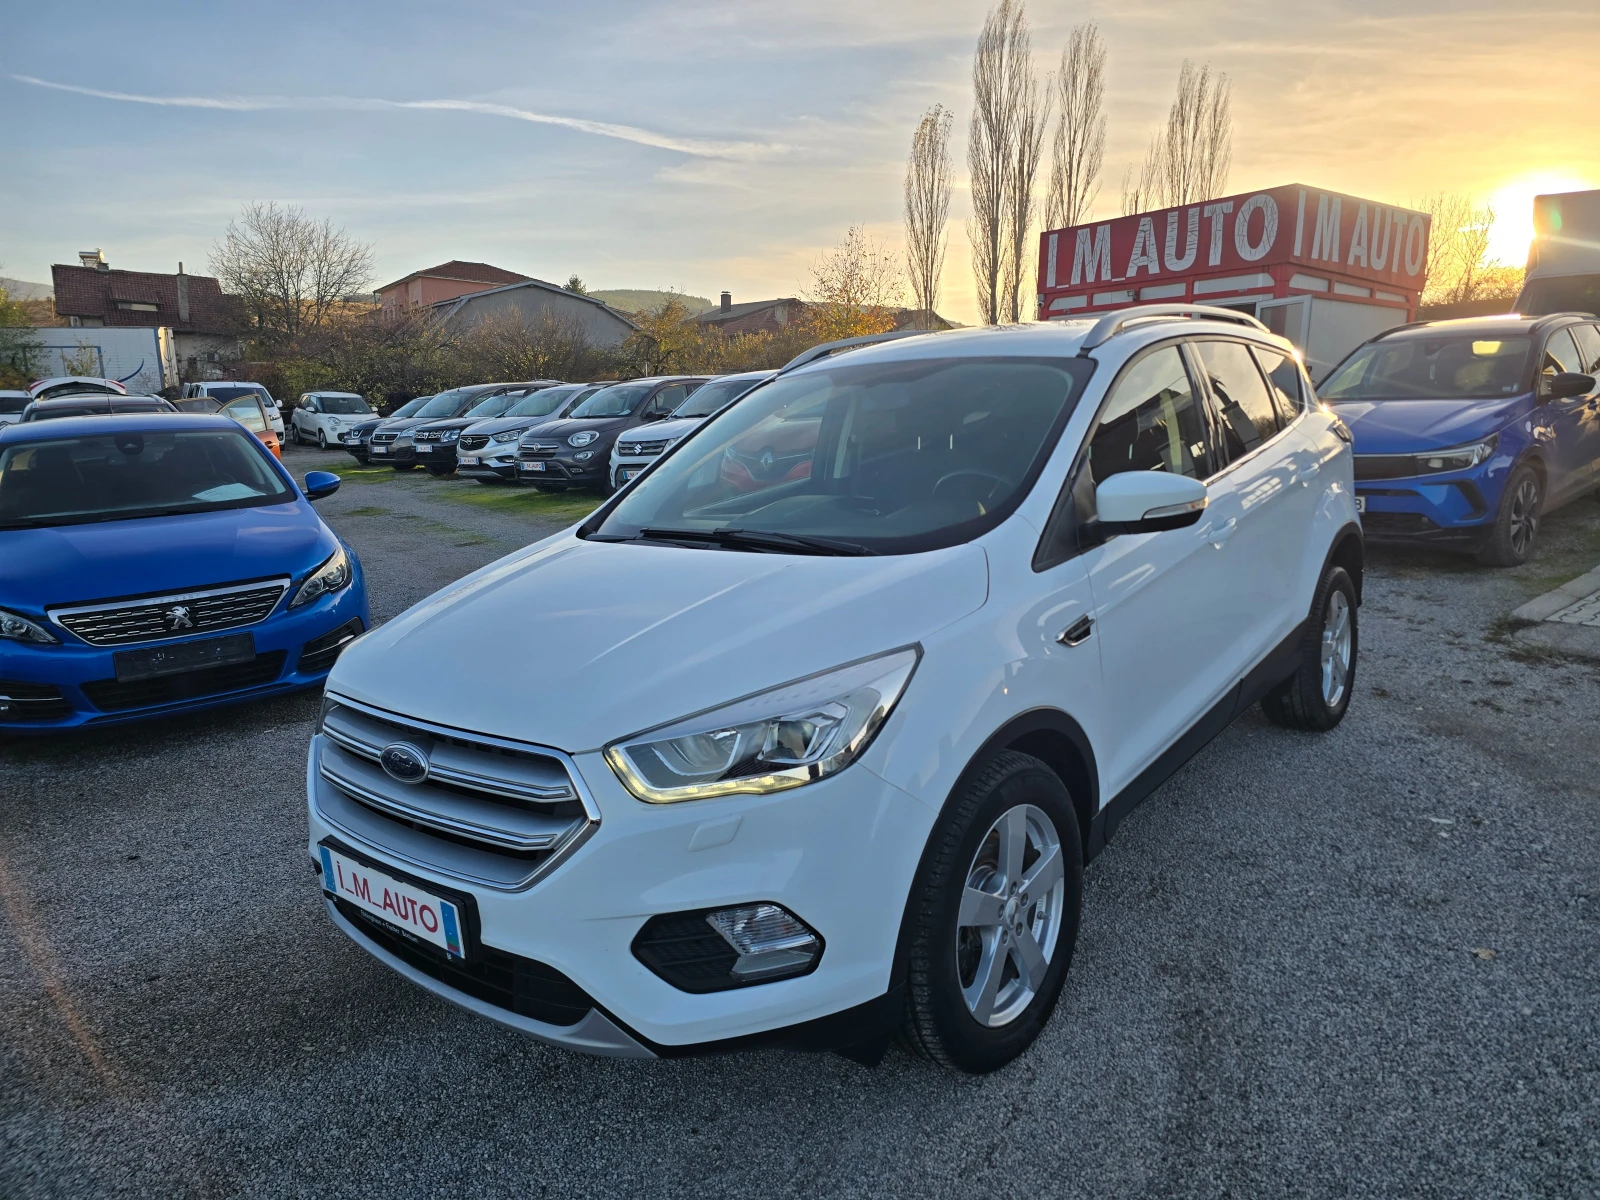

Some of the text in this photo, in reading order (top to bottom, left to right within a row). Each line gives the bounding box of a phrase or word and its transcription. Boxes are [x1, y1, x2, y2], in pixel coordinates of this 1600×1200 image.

[1293, 189, 1425, 277] I M AUTO
